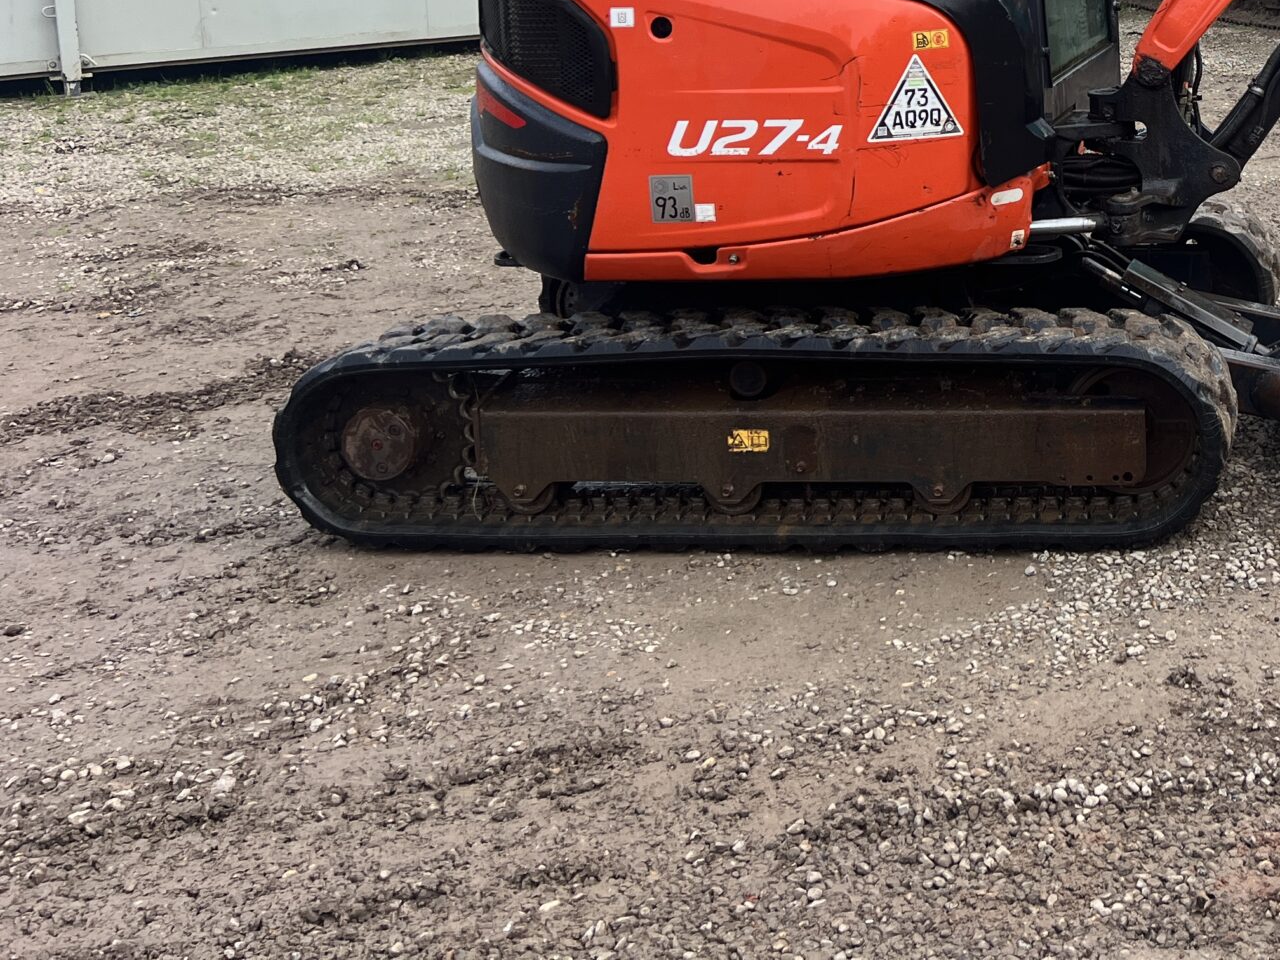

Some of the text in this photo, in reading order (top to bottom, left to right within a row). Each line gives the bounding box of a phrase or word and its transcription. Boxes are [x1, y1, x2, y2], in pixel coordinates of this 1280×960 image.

[905, 87, 929, 108] 73
[892, 108, 942, 130] AQ9Q
[667, 119, 843, 157] U27-4
[655, 196, 678, 219] 93
